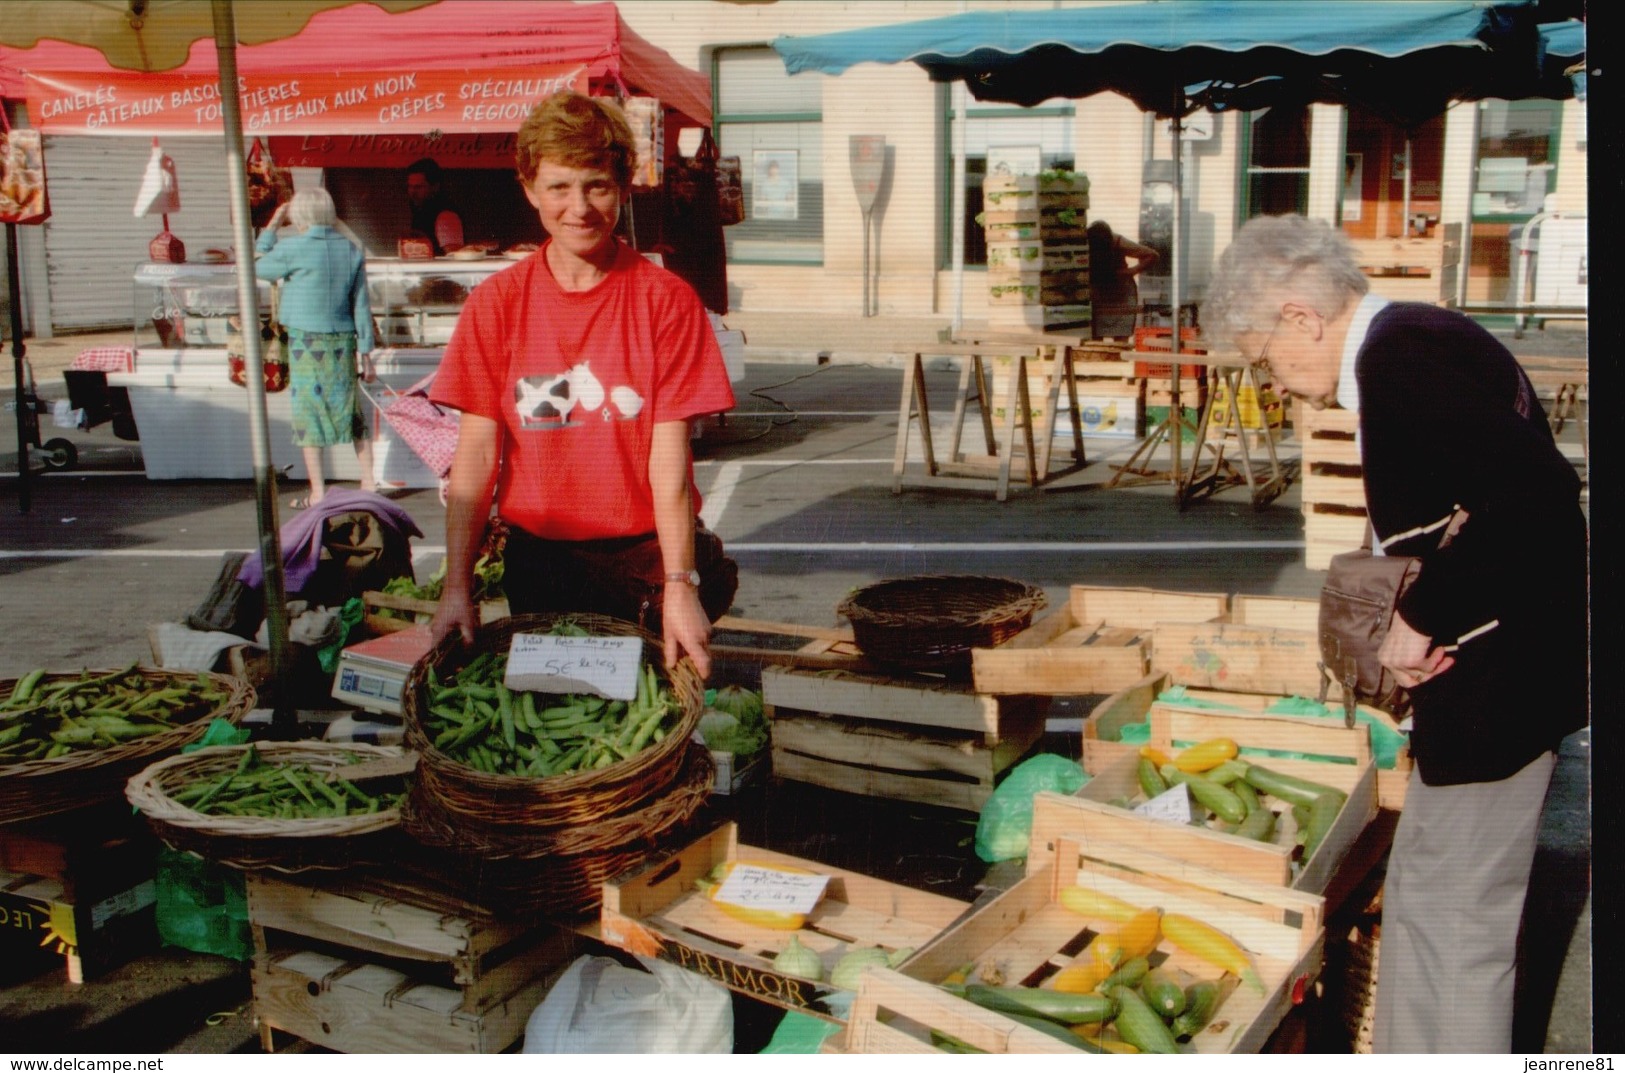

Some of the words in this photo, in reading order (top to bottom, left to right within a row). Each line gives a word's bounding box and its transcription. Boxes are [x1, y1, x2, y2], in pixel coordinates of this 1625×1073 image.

[41, 86, 117, 118] CANELÉS
[86, 96, 165, 129] GÂTEAUX
[171, 77, 248, 107] BASQUS
[194, 80, 301, 124] TOTIÈRES
[249, 96, 328, 130] GÂTEAUX
[334, 86, 369, 109] AUX
[374, 72, 417, 98] NOIX
[378, 93, 446, 123] CRÊPES
[678, 944, 809, 1008] PRIMOR
